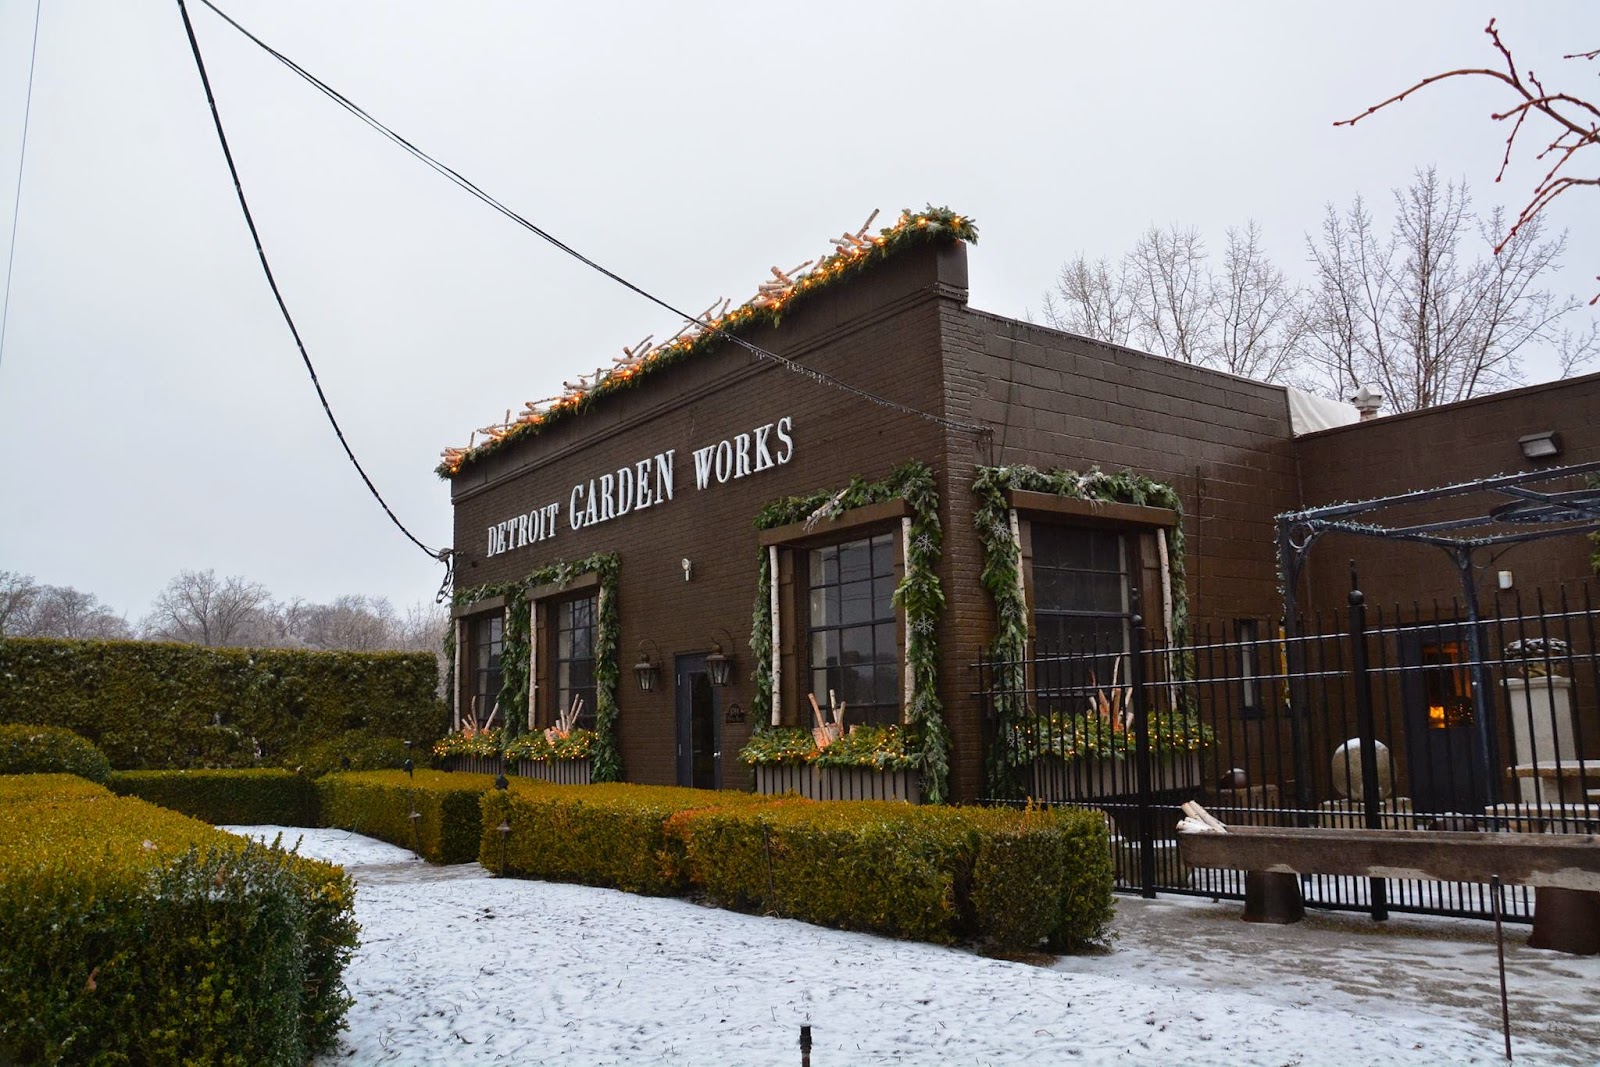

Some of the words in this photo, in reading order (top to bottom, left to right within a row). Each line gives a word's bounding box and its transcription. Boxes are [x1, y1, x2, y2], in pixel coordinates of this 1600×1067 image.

[487, 503, 560, 558] DETROIT
[569, 449, 676, 531] GARDEN
[692, 416, 794, 491] WORKS
